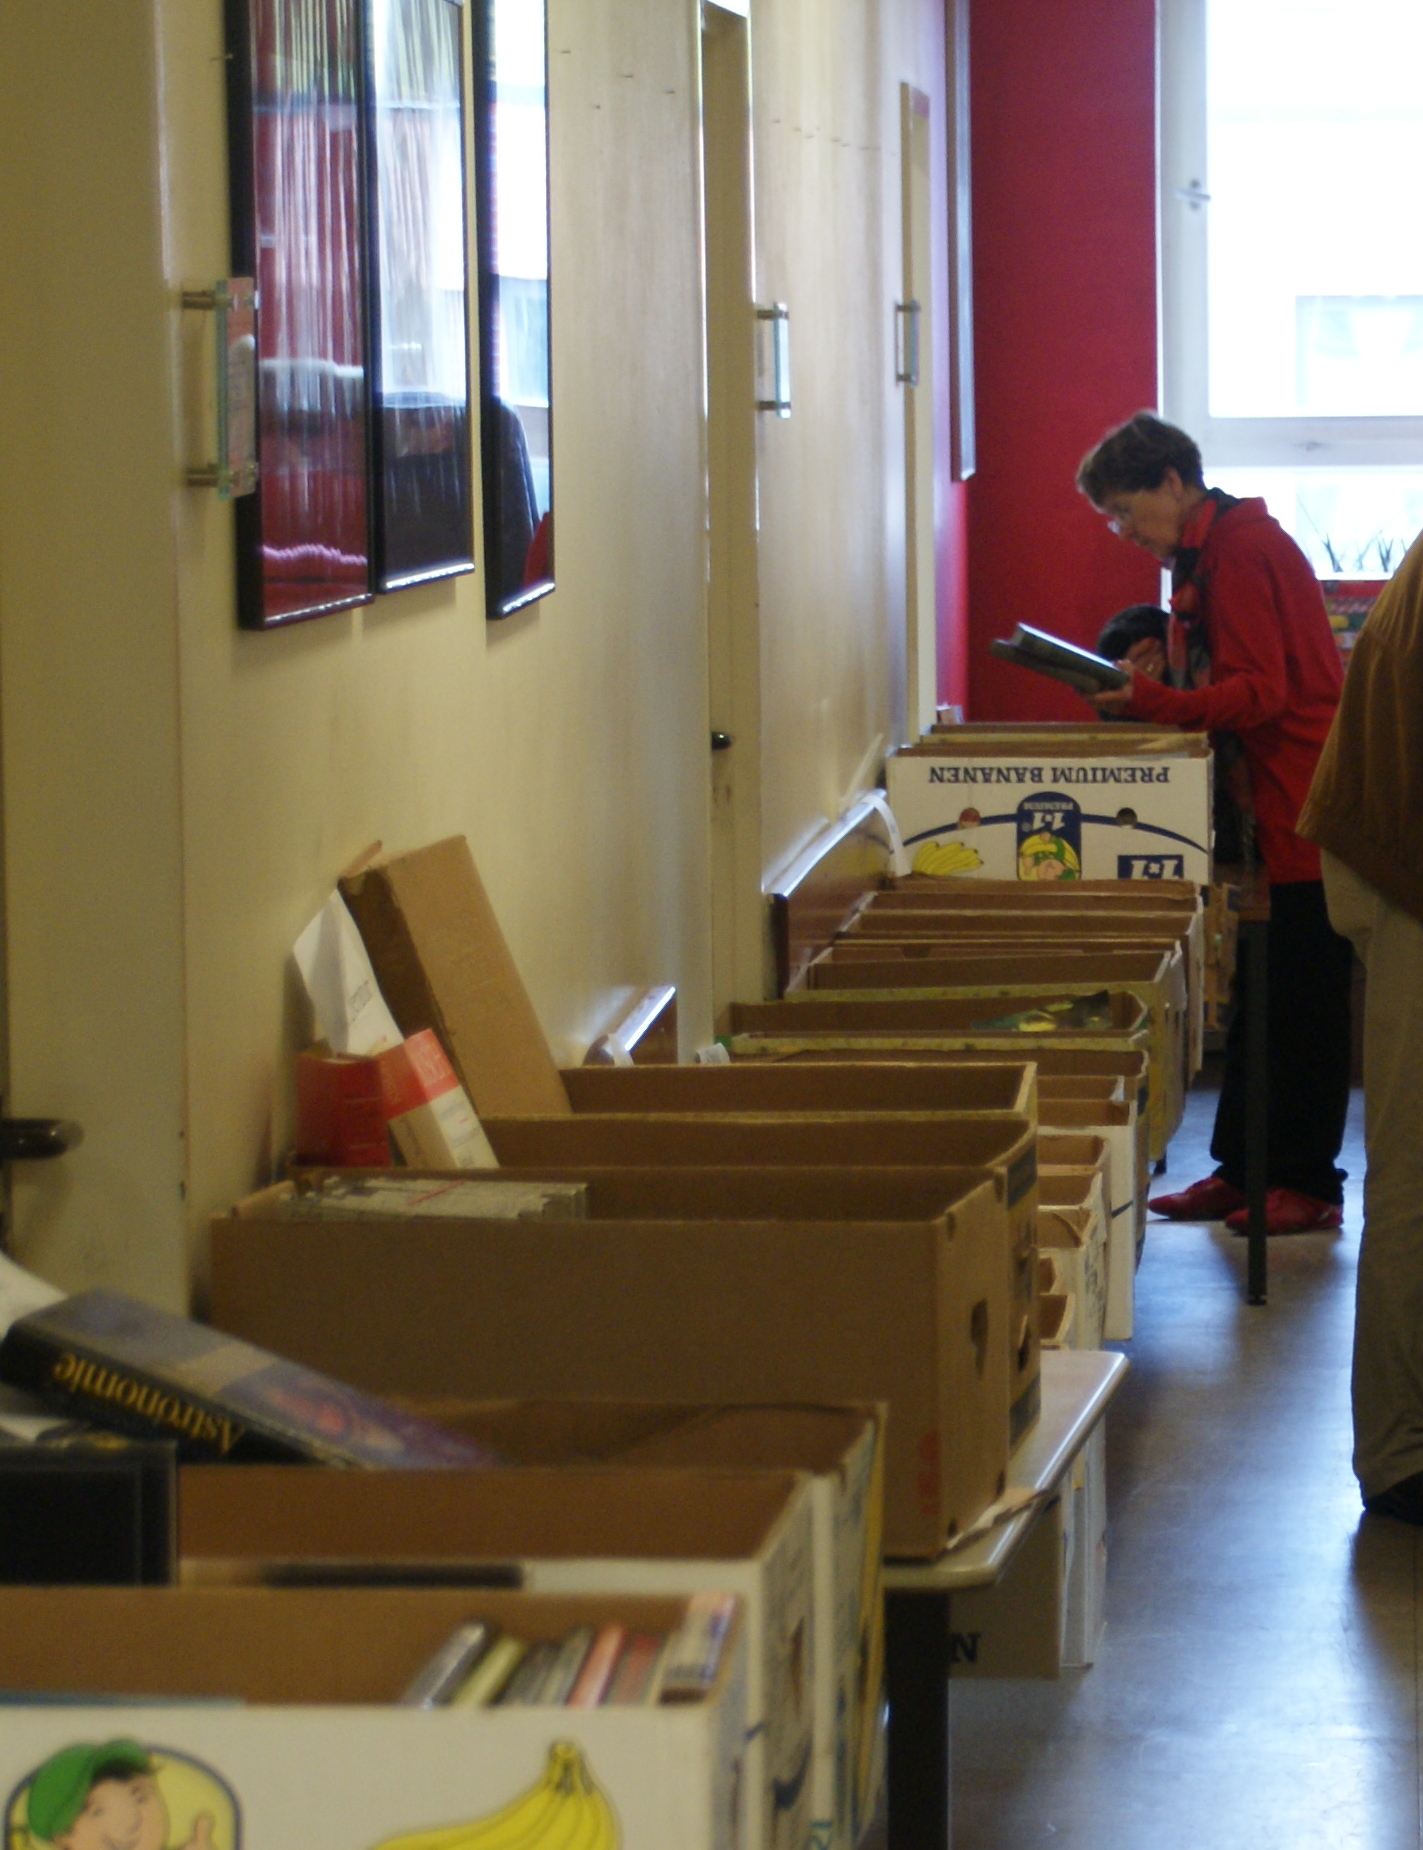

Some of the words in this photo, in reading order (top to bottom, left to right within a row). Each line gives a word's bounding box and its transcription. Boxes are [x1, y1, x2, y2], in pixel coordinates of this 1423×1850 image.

[928, 766, 1044, 784] BANANEN
[1051, 766, 1171, 784] PREMIUM
[53, 1352, 247, 1453] Astronomie
